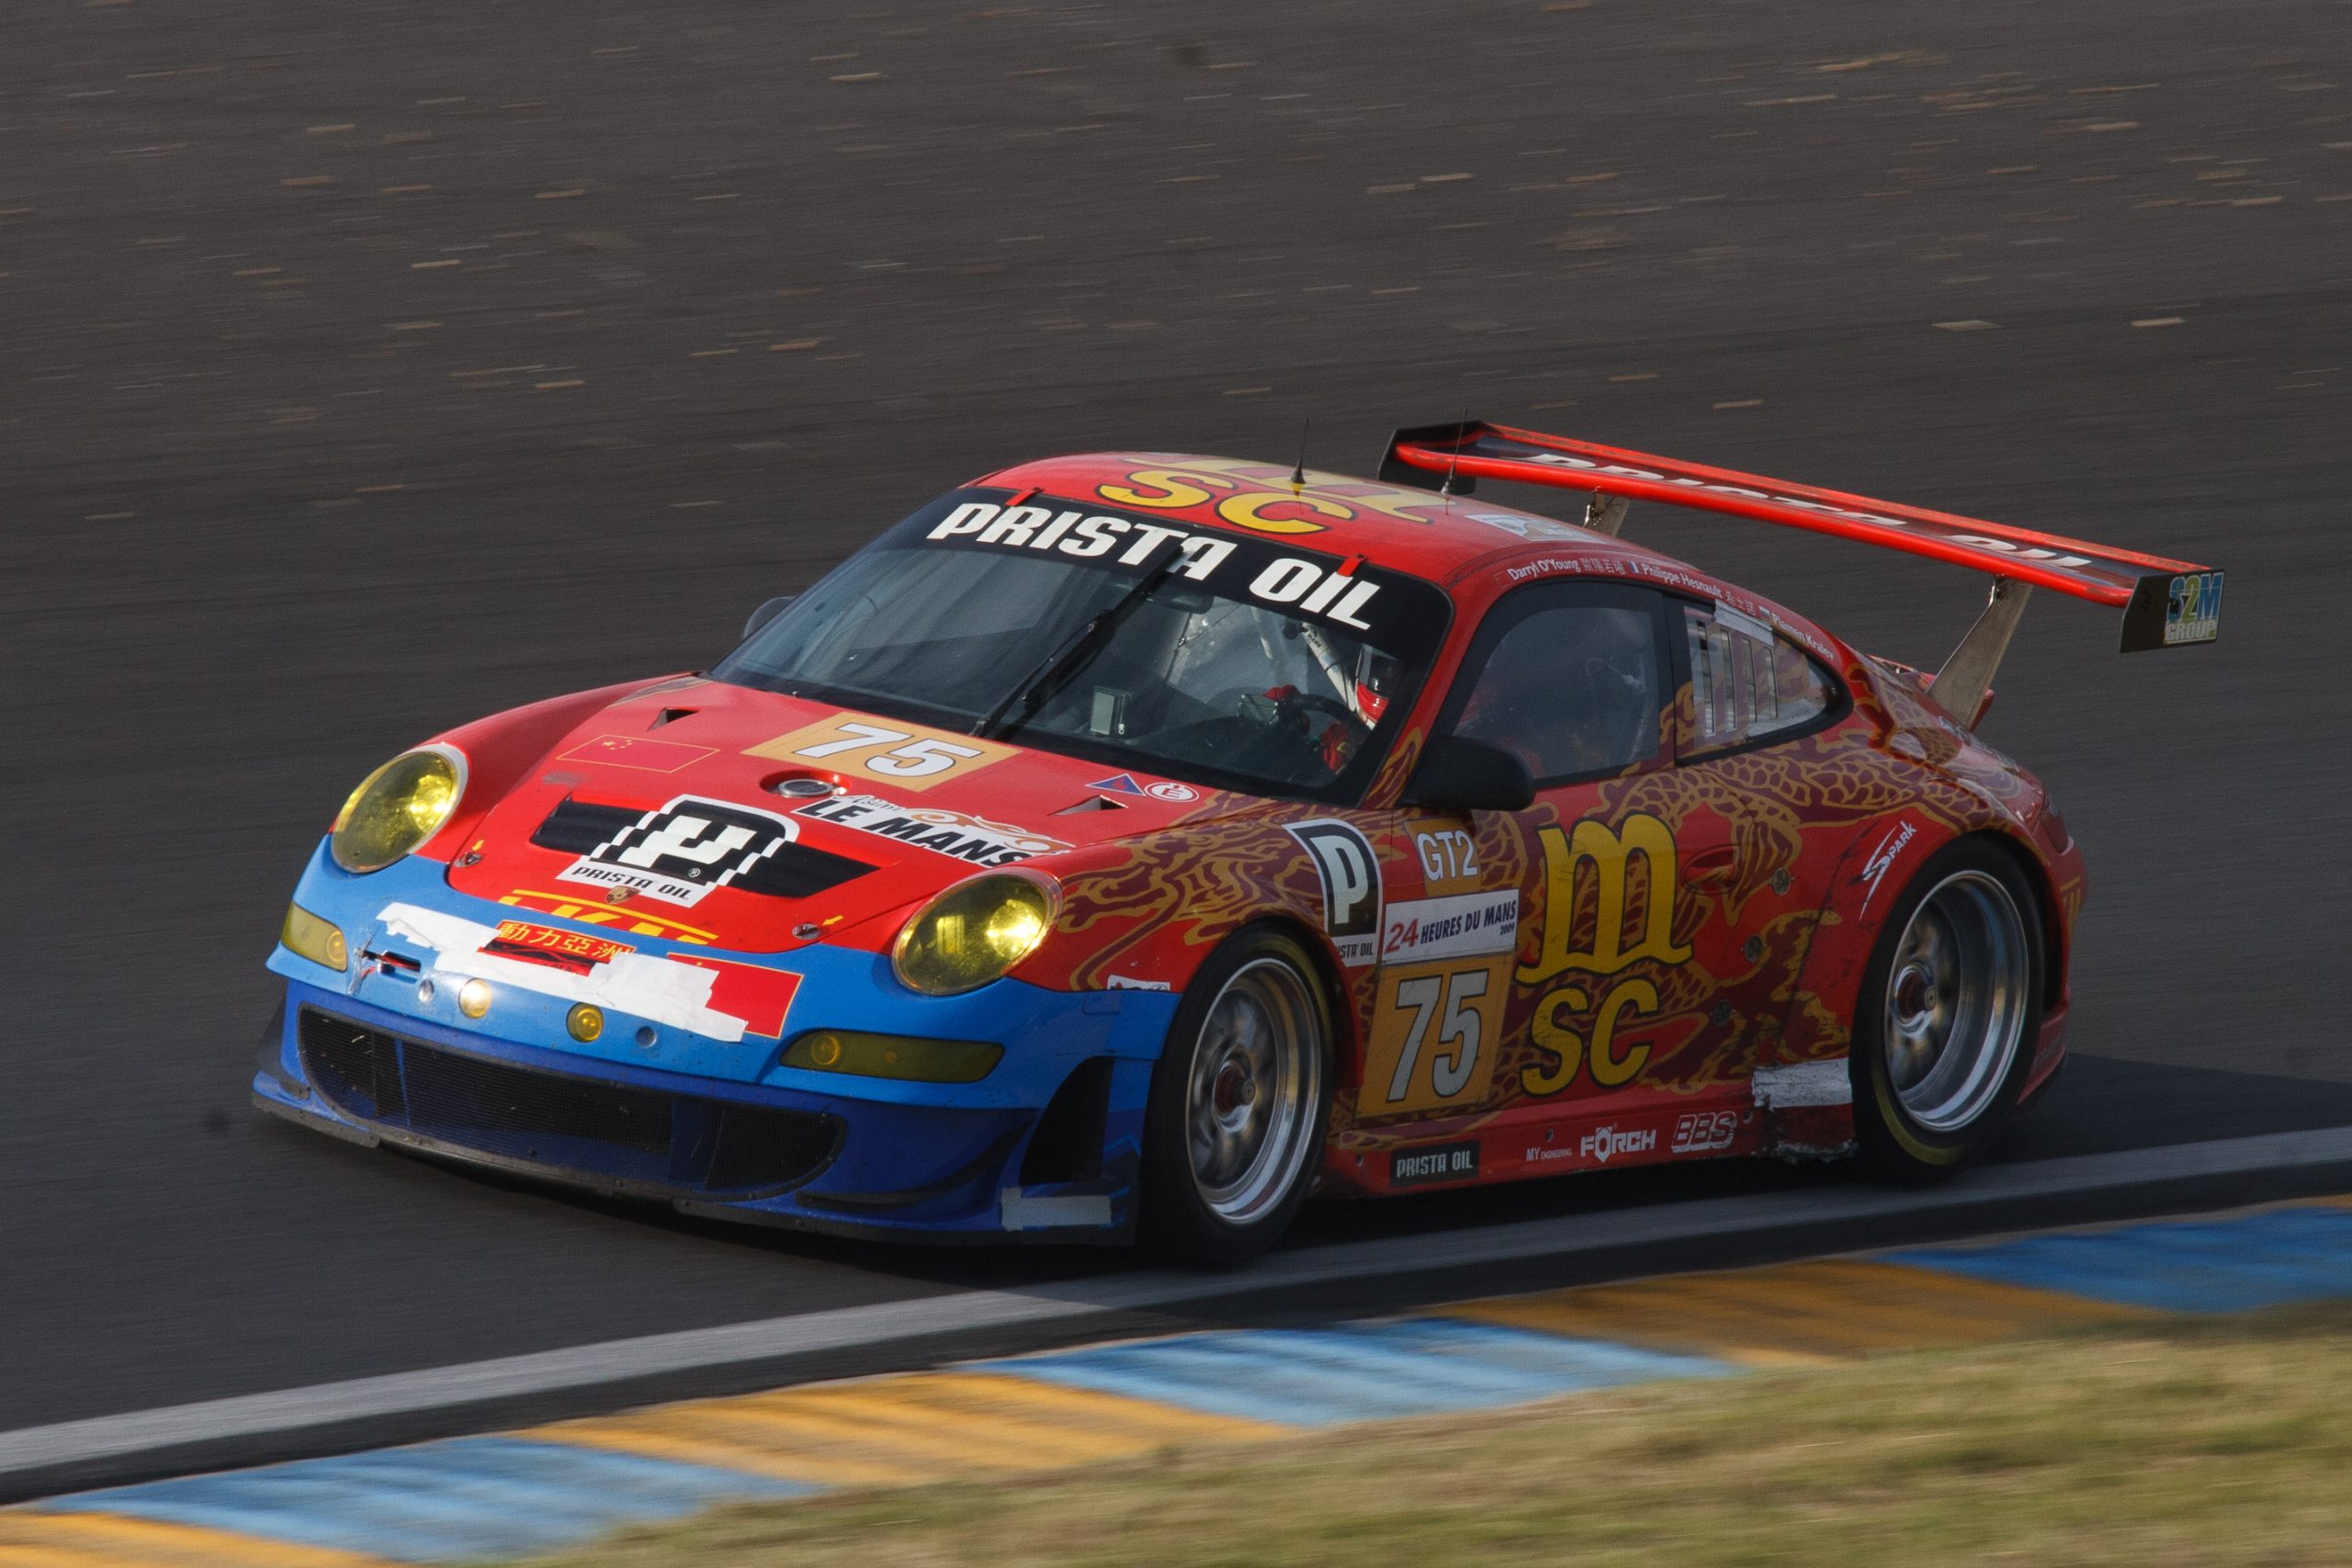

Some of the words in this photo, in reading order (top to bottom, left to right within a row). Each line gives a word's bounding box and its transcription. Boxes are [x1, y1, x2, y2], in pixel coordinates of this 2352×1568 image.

[926, 502, 1238, 581] PRISTA
[1249, 558, 1381, 630] OIL
[1507, 561, 1539, 581] Darryl
[1641, 562, 1682, 586] Philippe
[2166, 571, 2224, 624] S2M
[2165, 619, 2217, 641] GROUP
[797, 721, 984, 778] 75
[796, 799, 873, 823] LE
[862, 817, 1037, 867] MANS
[1417, 829, 1478, 883] GT2
[573, 866, 654, 888] PRISTA
[657, 884, 692, 900] OIL
[1309, 834, 1369, 926] P
[1360, 942, 1374, 957] OIL
[1384, 918, 1419, 955] 24
[1420, 914, 1463, 945] HEURES
[1464, 909, 1481, 932] DU
[1483, 899, 1517, 928] MANS
[1385, 967, 1490, 1100] 75
[1519, 976, 1659, 1098] SC
[1525, 1146, 1542, 1162] MY
[1670, 1110, 1738, 1155] BBS
[1396, 1152, 1447, 1178] PRISTA
[1452, 1149, 1475, 1172] OIL
